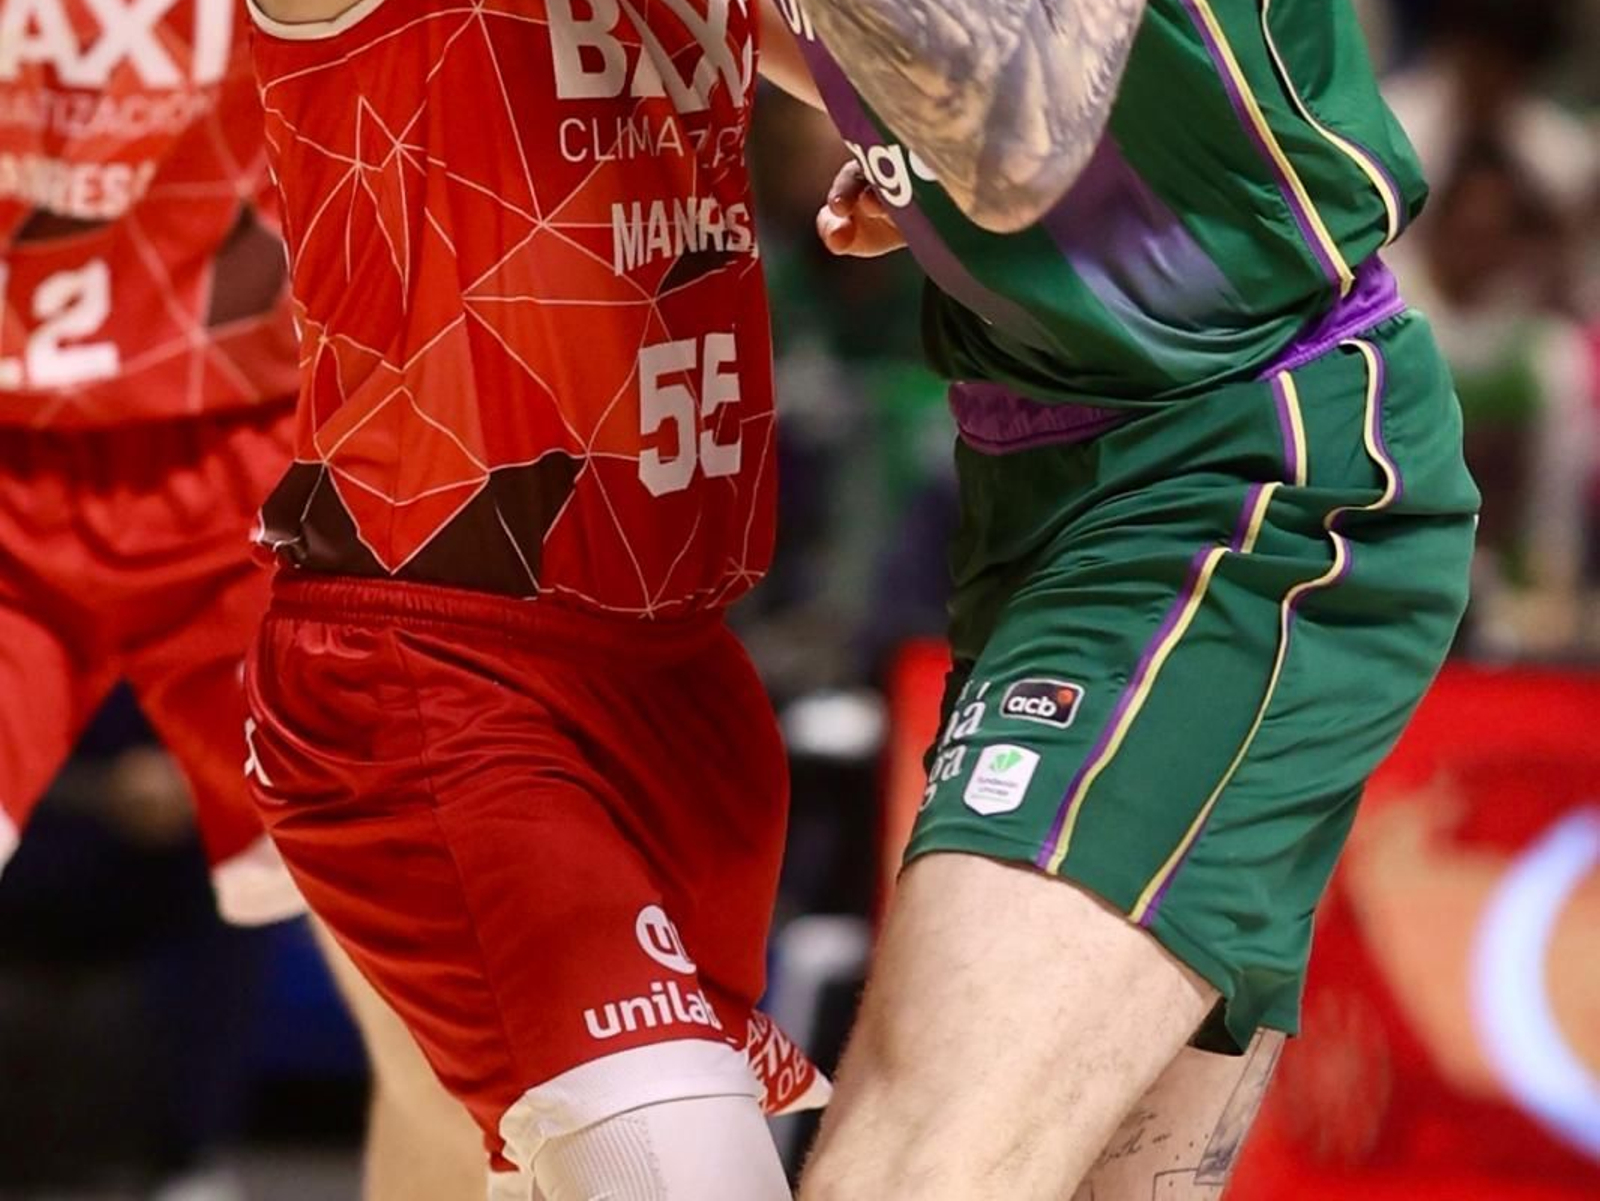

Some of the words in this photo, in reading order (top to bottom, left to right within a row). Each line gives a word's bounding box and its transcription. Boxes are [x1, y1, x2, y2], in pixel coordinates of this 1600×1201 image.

[637, 331, 743, 498] 55
[1006, 695, 1058, 717] acb
[583, 980, 724, 1039] unila
